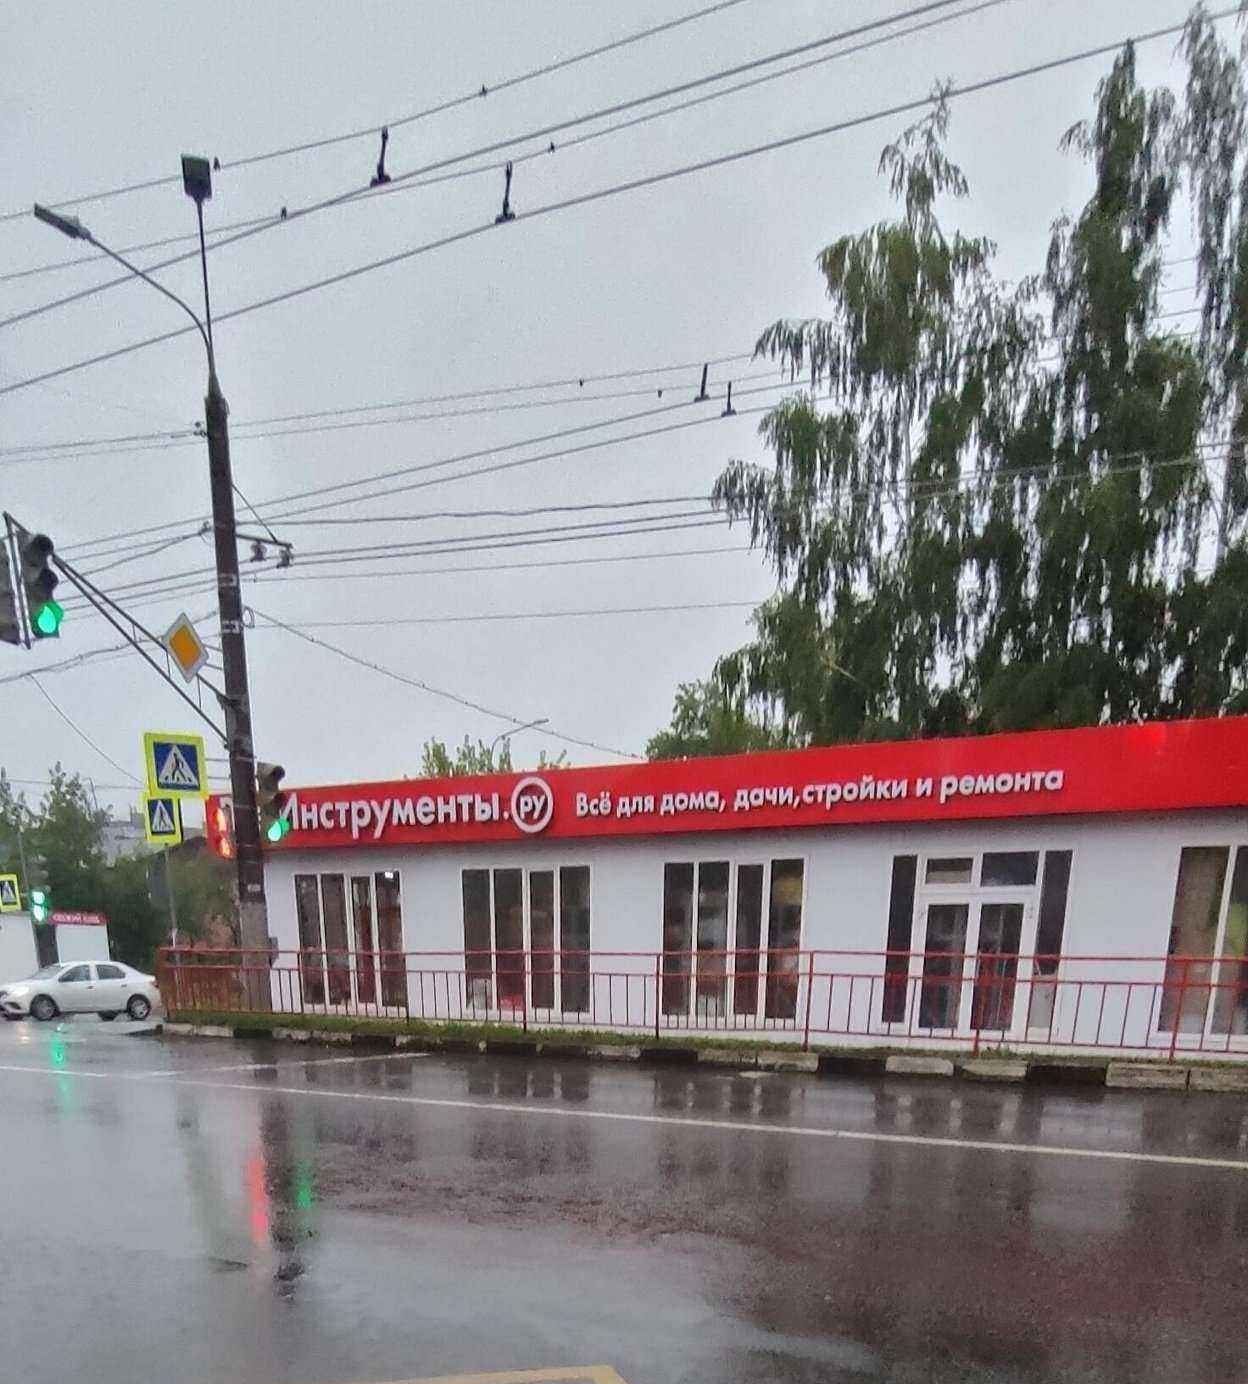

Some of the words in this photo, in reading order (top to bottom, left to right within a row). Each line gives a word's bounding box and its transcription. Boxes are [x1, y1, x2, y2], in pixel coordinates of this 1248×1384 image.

[576, 791, 611, 817] Всё
[616, 794, 655, 818] для
[660, 790, 727, 816] дома,
[915, 777, 934, 798] и
[940, 769, 1065, 804] ремонта
